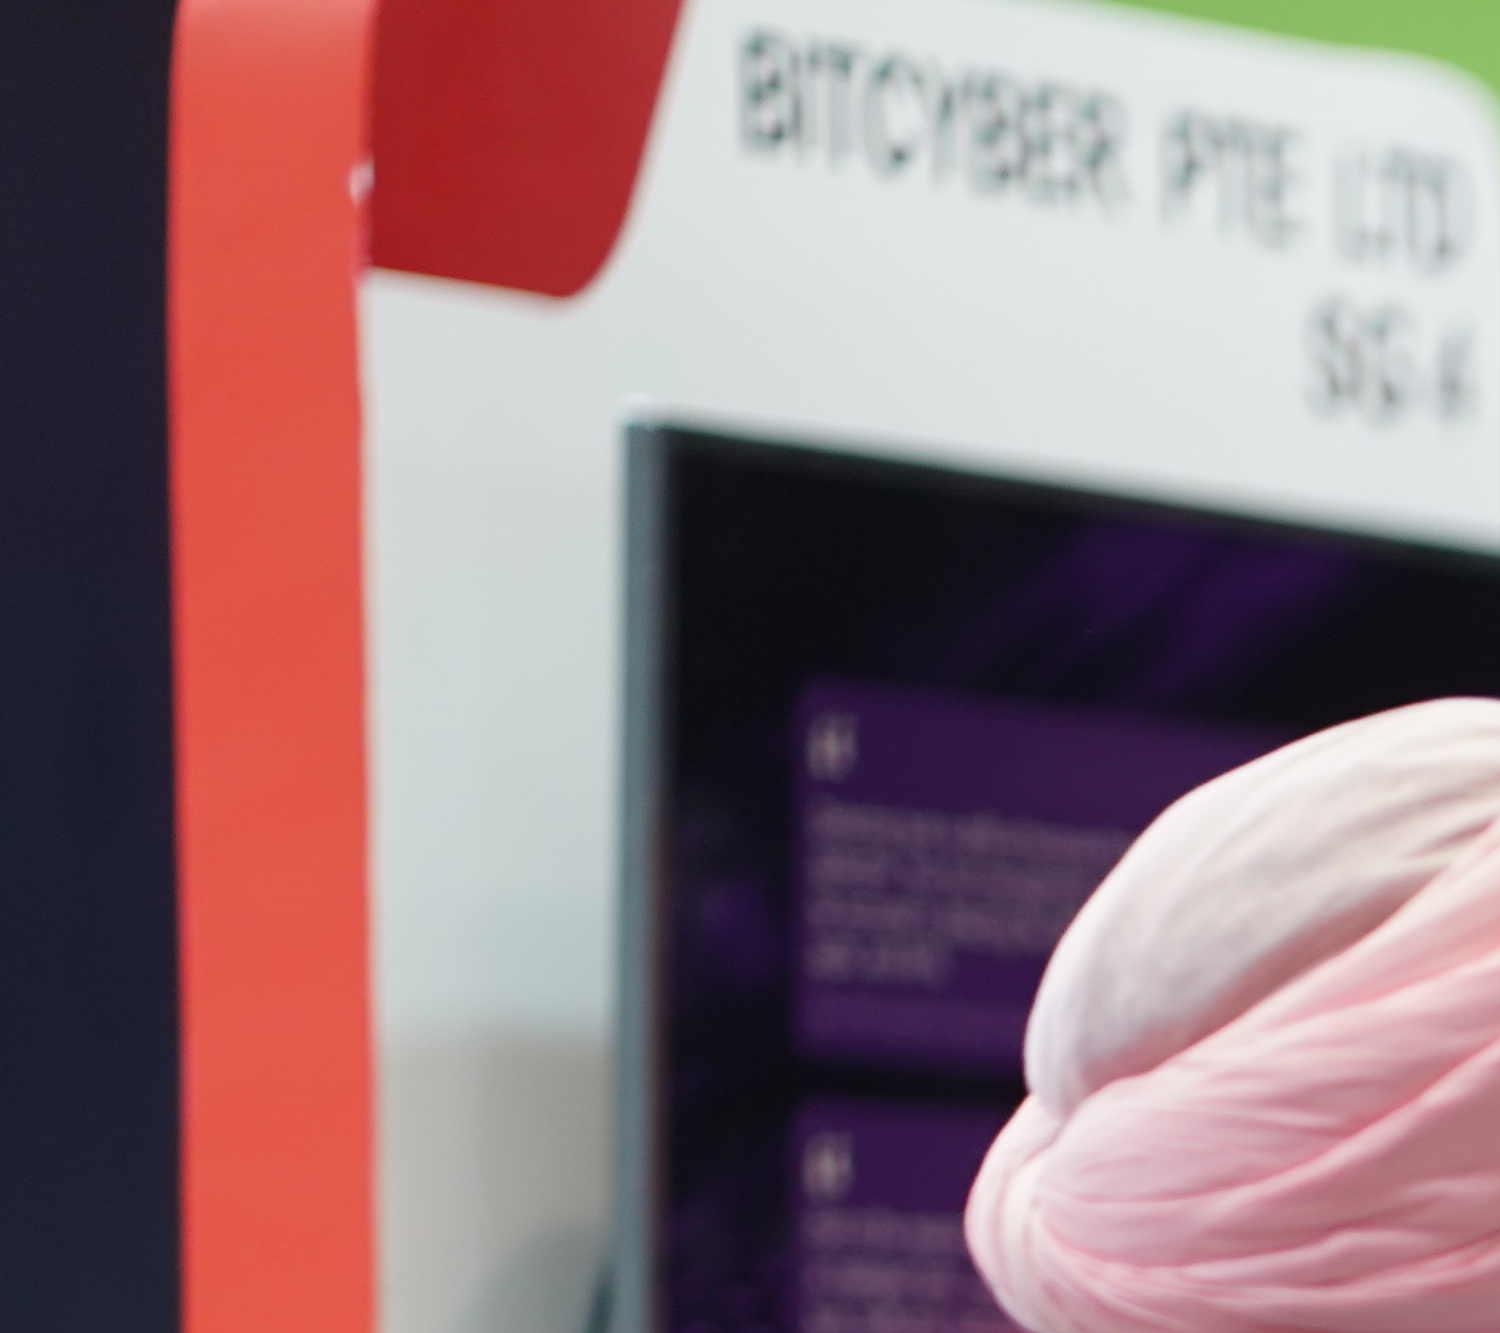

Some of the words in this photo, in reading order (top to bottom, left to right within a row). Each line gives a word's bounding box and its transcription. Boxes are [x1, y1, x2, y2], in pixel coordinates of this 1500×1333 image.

[738, 28, 1130, 214] BITCYBER
[1158, 108, 1309, 256] PTE
[1331, 134, 1476, 276] LTD
